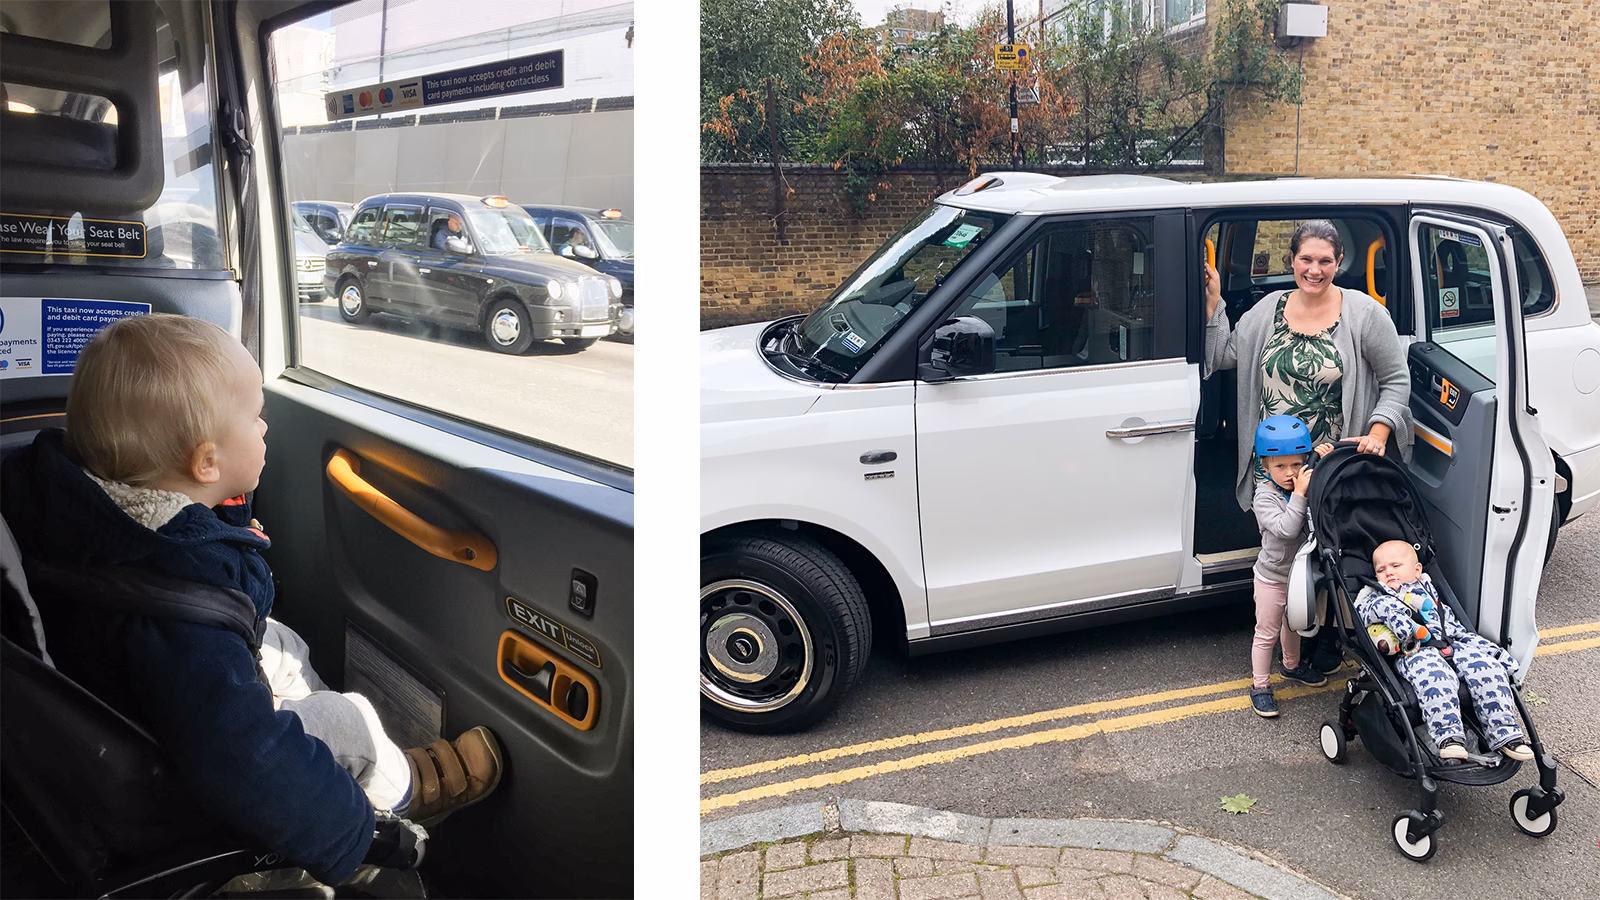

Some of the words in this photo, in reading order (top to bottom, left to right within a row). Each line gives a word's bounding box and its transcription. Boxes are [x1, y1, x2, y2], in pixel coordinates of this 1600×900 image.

[426, 81, 439, 89] This
[440, 78, 453, 86] taxi
[453, 76, 467, 85] now
[468, 71, 495, 82] accepts
[496, 66, 517, 77] credit
[519, 63, 533, 73] and
[535, 59, 556, 71] debit
[402, 89, 417, 99] VISA
[427, 91, 440, 100] card
[441, 87, 473, 99] payments
[473, 80, 505, 93] including
[506, 74, 550, 88] contactless
[89, 226, 115, 239] Seat
[118, 228, 140, 240] Belt
[63, 306, 78, 314] taxi
[95, 308, 122, 317] accepts
[513, 602, 559, 639] EXIT
[565, 632, 595, 654] Unlock
